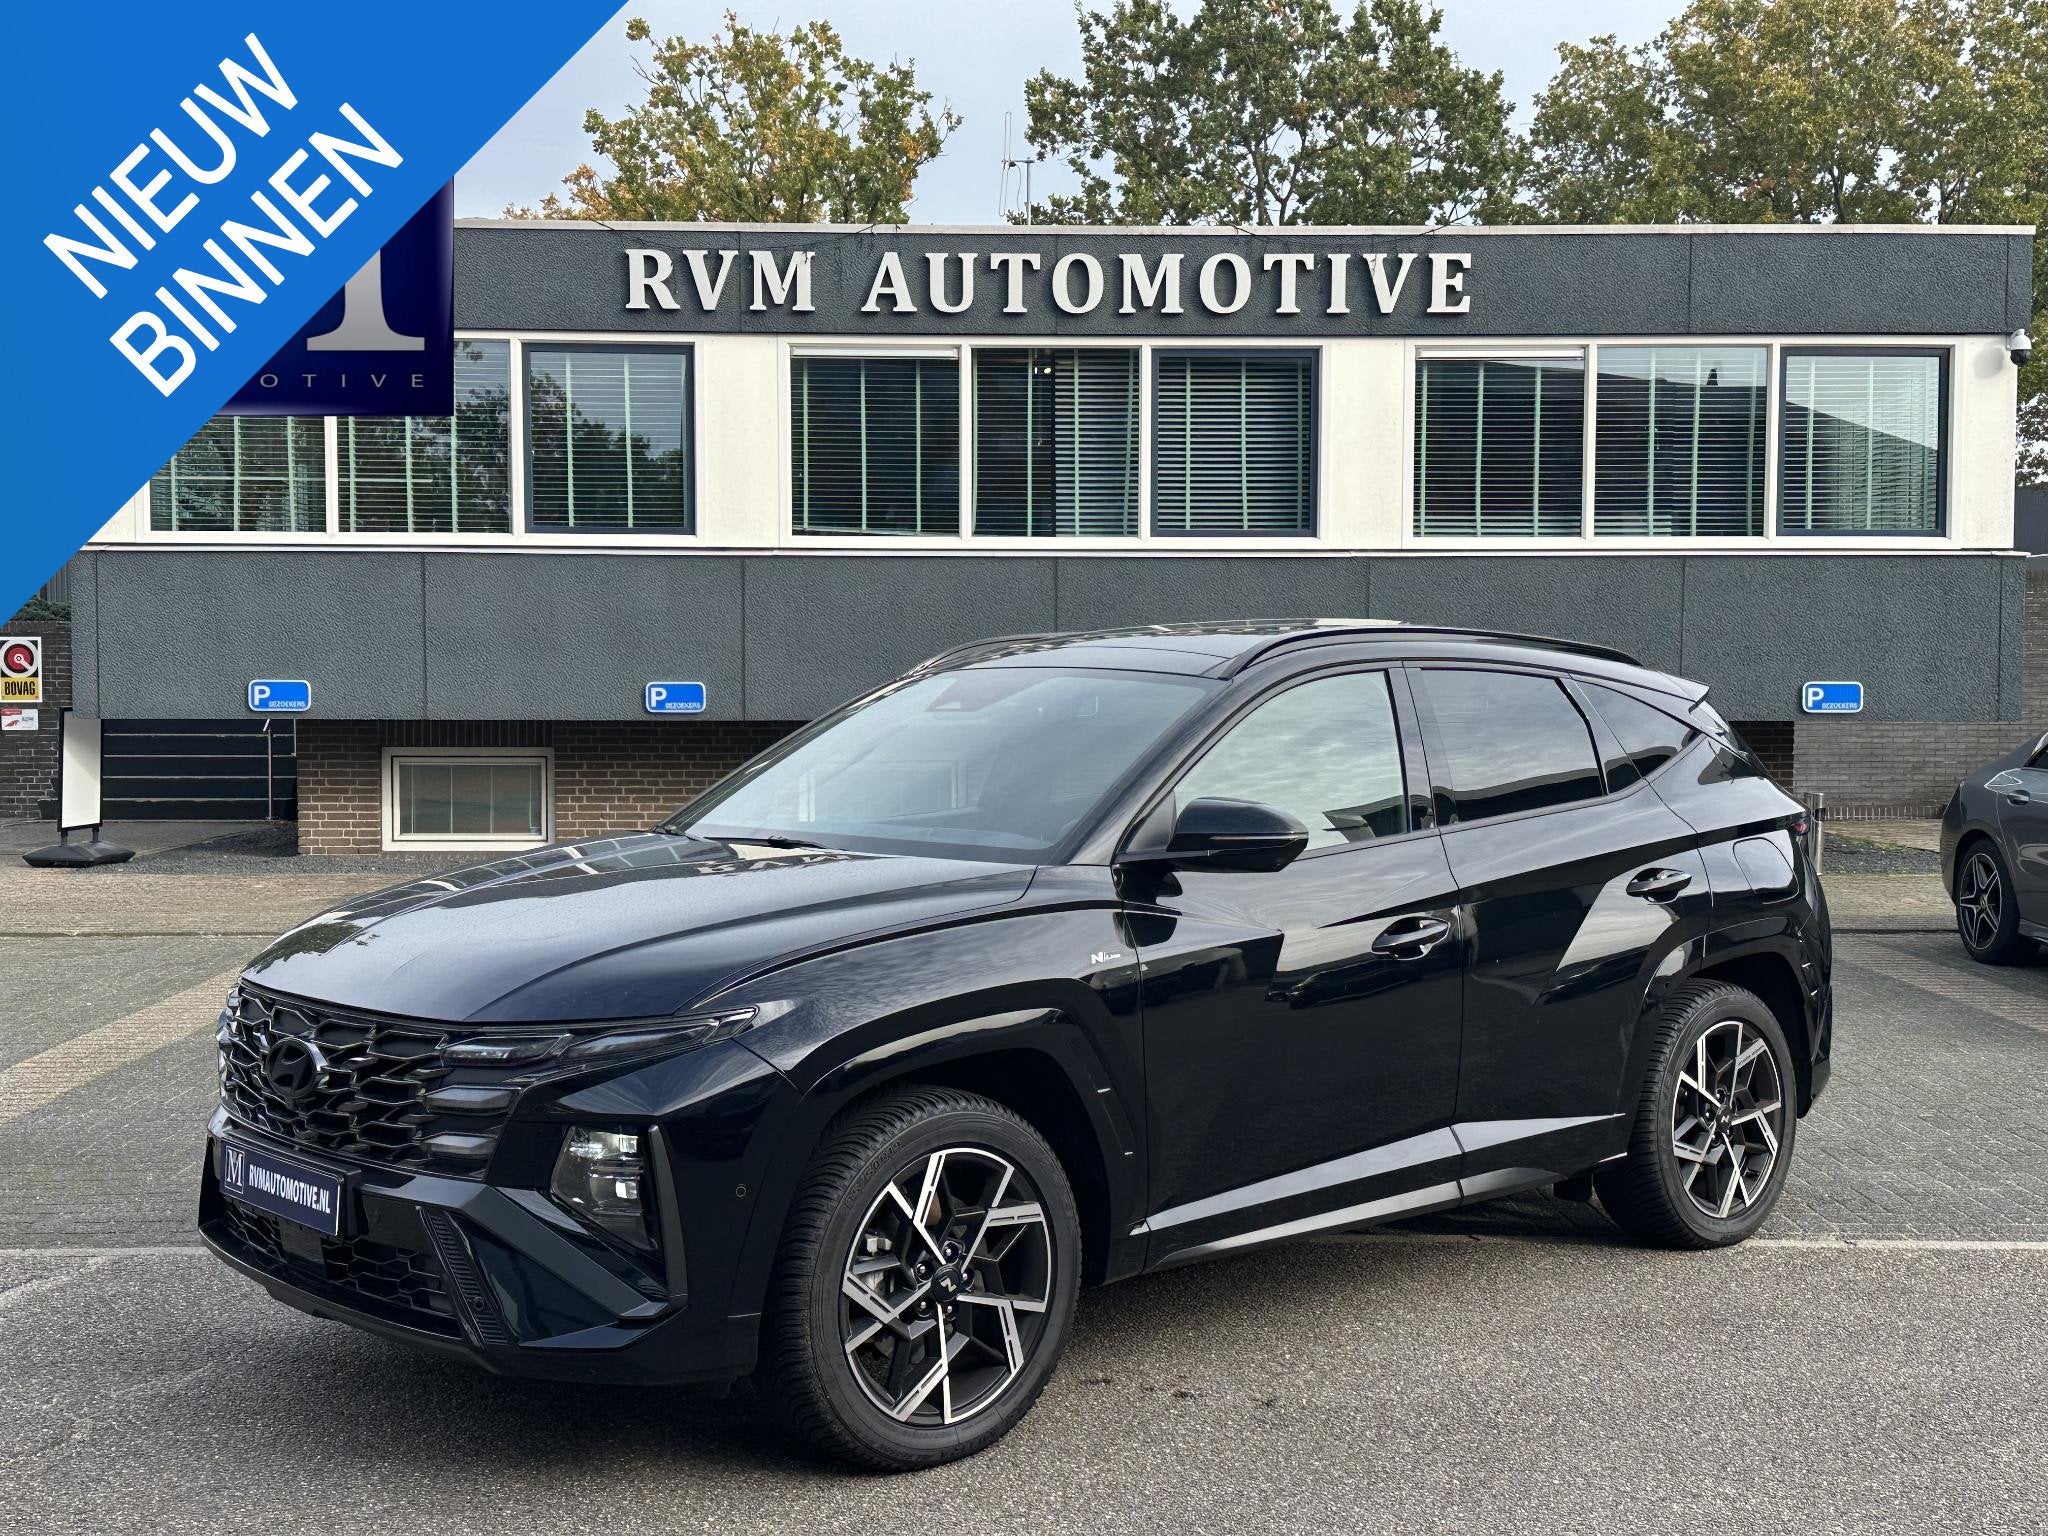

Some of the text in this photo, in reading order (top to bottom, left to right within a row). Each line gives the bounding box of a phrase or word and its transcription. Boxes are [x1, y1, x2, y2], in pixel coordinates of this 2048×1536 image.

[625, 248, 1473, 314] RVM AUTOMOTIVE
[4, 681, 36, 696] BOVAG
[254, 685, 271, 706] P
[651, 687, 667, 708] P
[1807, 687, 1824, 708] P
[248, 1164, 331, 1214] RVMAUTOMOTIVE.NL
